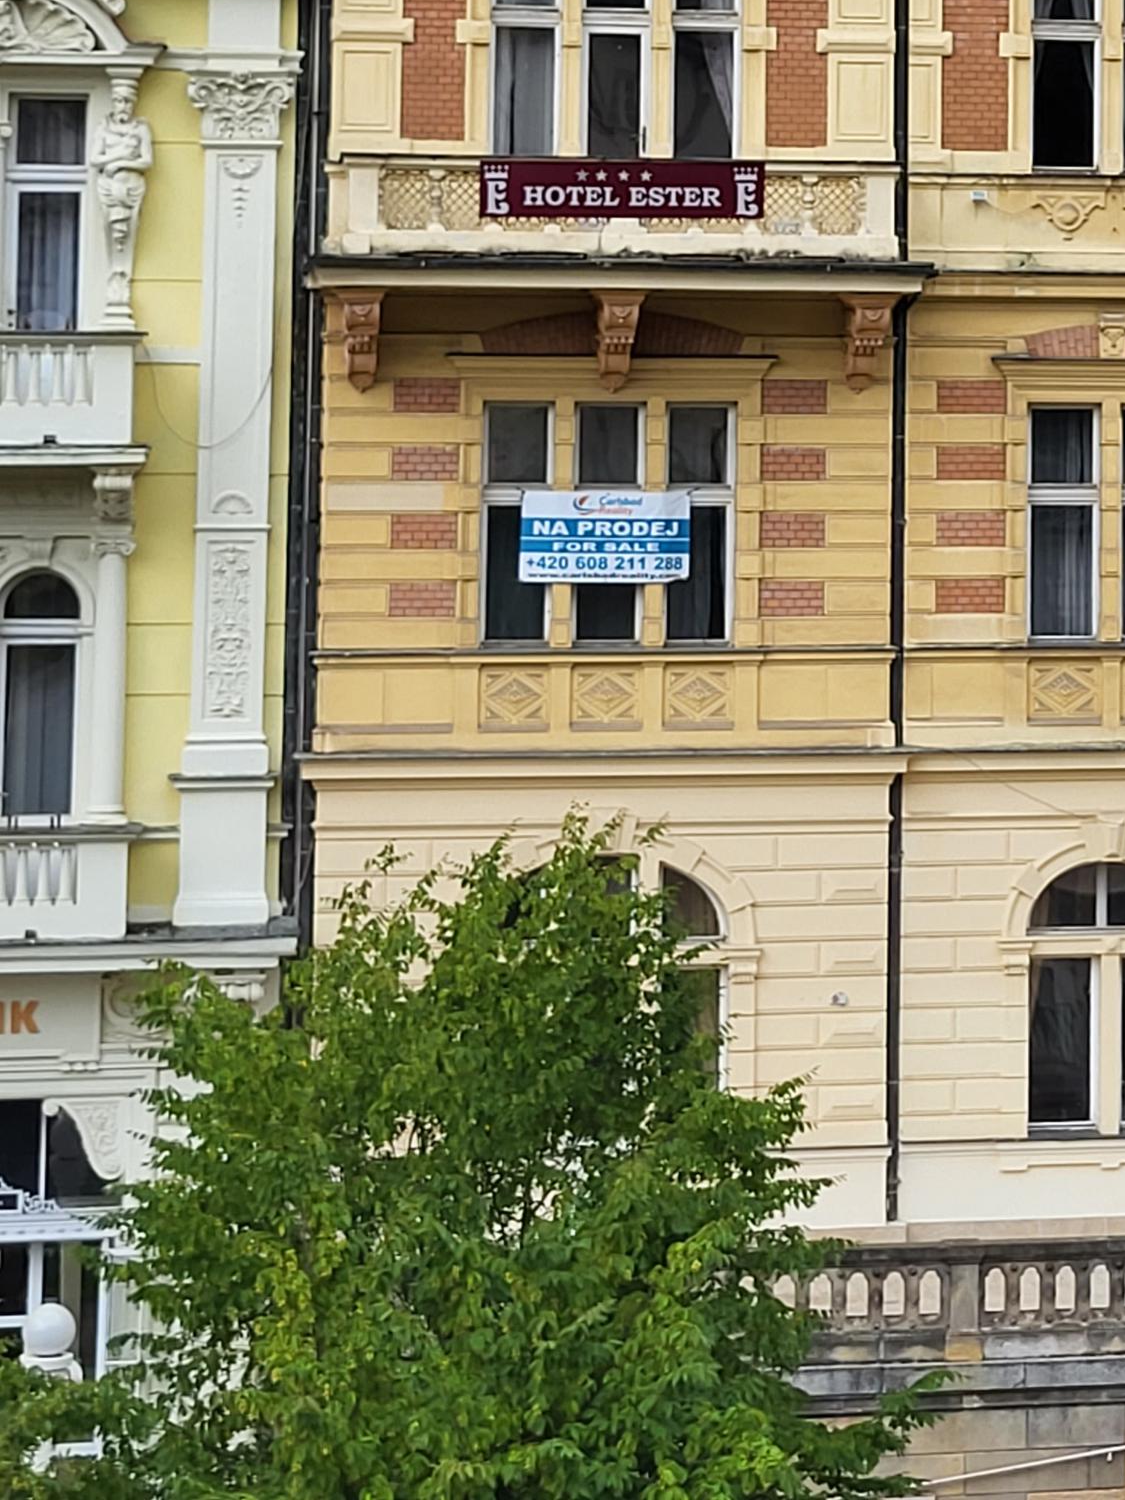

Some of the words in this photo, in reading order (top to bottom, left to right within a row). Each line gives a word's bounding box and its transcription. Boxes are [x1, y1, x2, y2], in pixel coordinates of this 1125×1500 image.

[523, 186, 620, 207] HOTEL
[629, 187, 722, 207] ESTER
[532, 520, 569, 536] NA
[577, 521, 679, 537] PRODEJ
[553, 542, 597, 552] FOR
[603, 542, 660, 552] SALE
[526, 557, 569, 570] +420
[575, 556, 608, 570] 608
[614, 556, 646, 570] 211
[654, 556, 683, 570] 288
